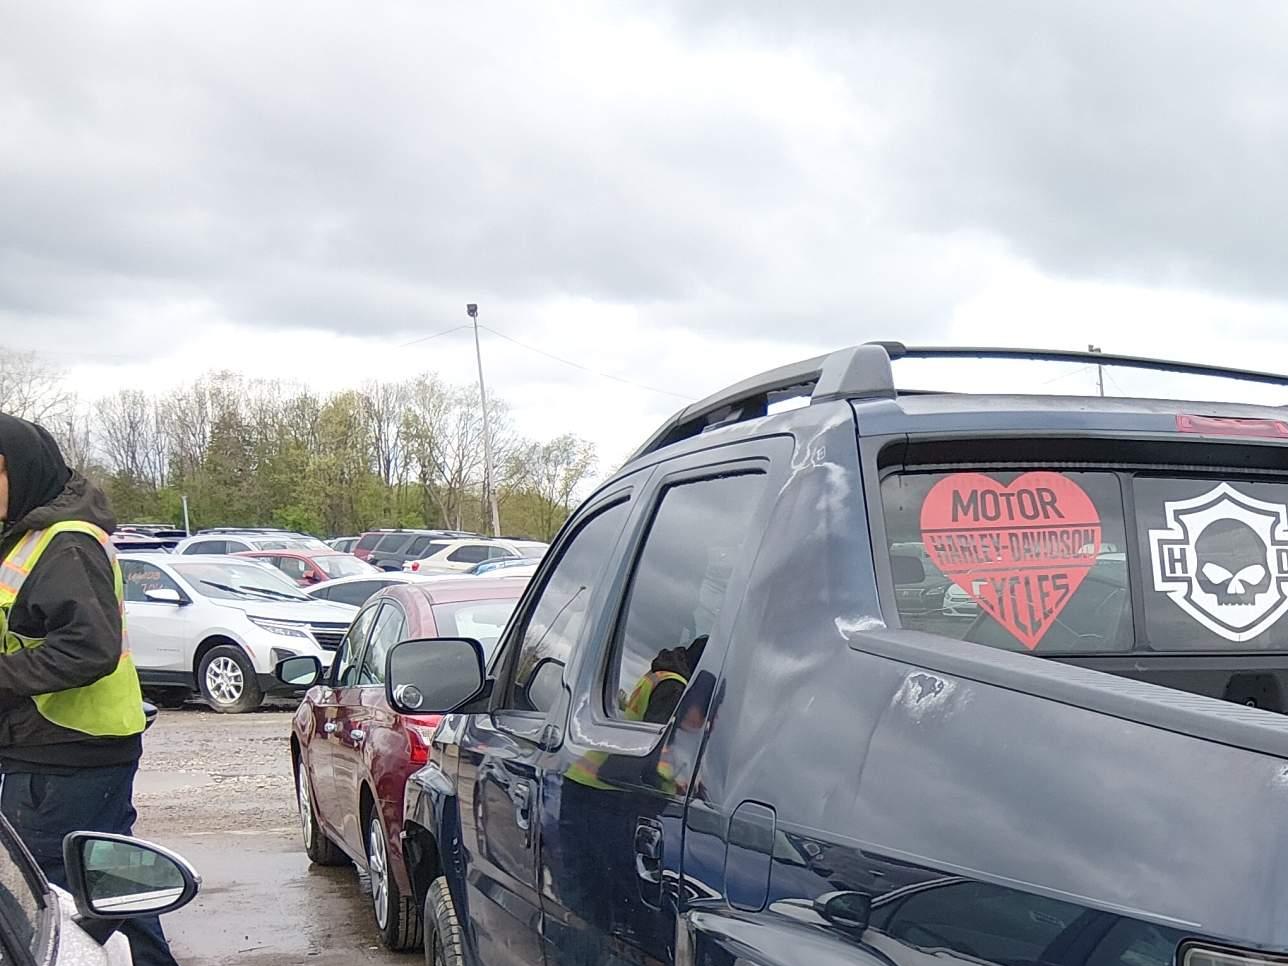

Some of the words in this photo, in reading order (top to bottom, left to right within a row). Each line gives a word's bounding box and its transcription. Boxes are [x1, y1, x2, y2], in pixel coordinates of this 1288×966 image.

[951, 488, 1065, 522] MOTOR
[930, 529, 1096, 565] HARLEY-DAVIDSON
[971, 573, 1070, 637] CYCLES
